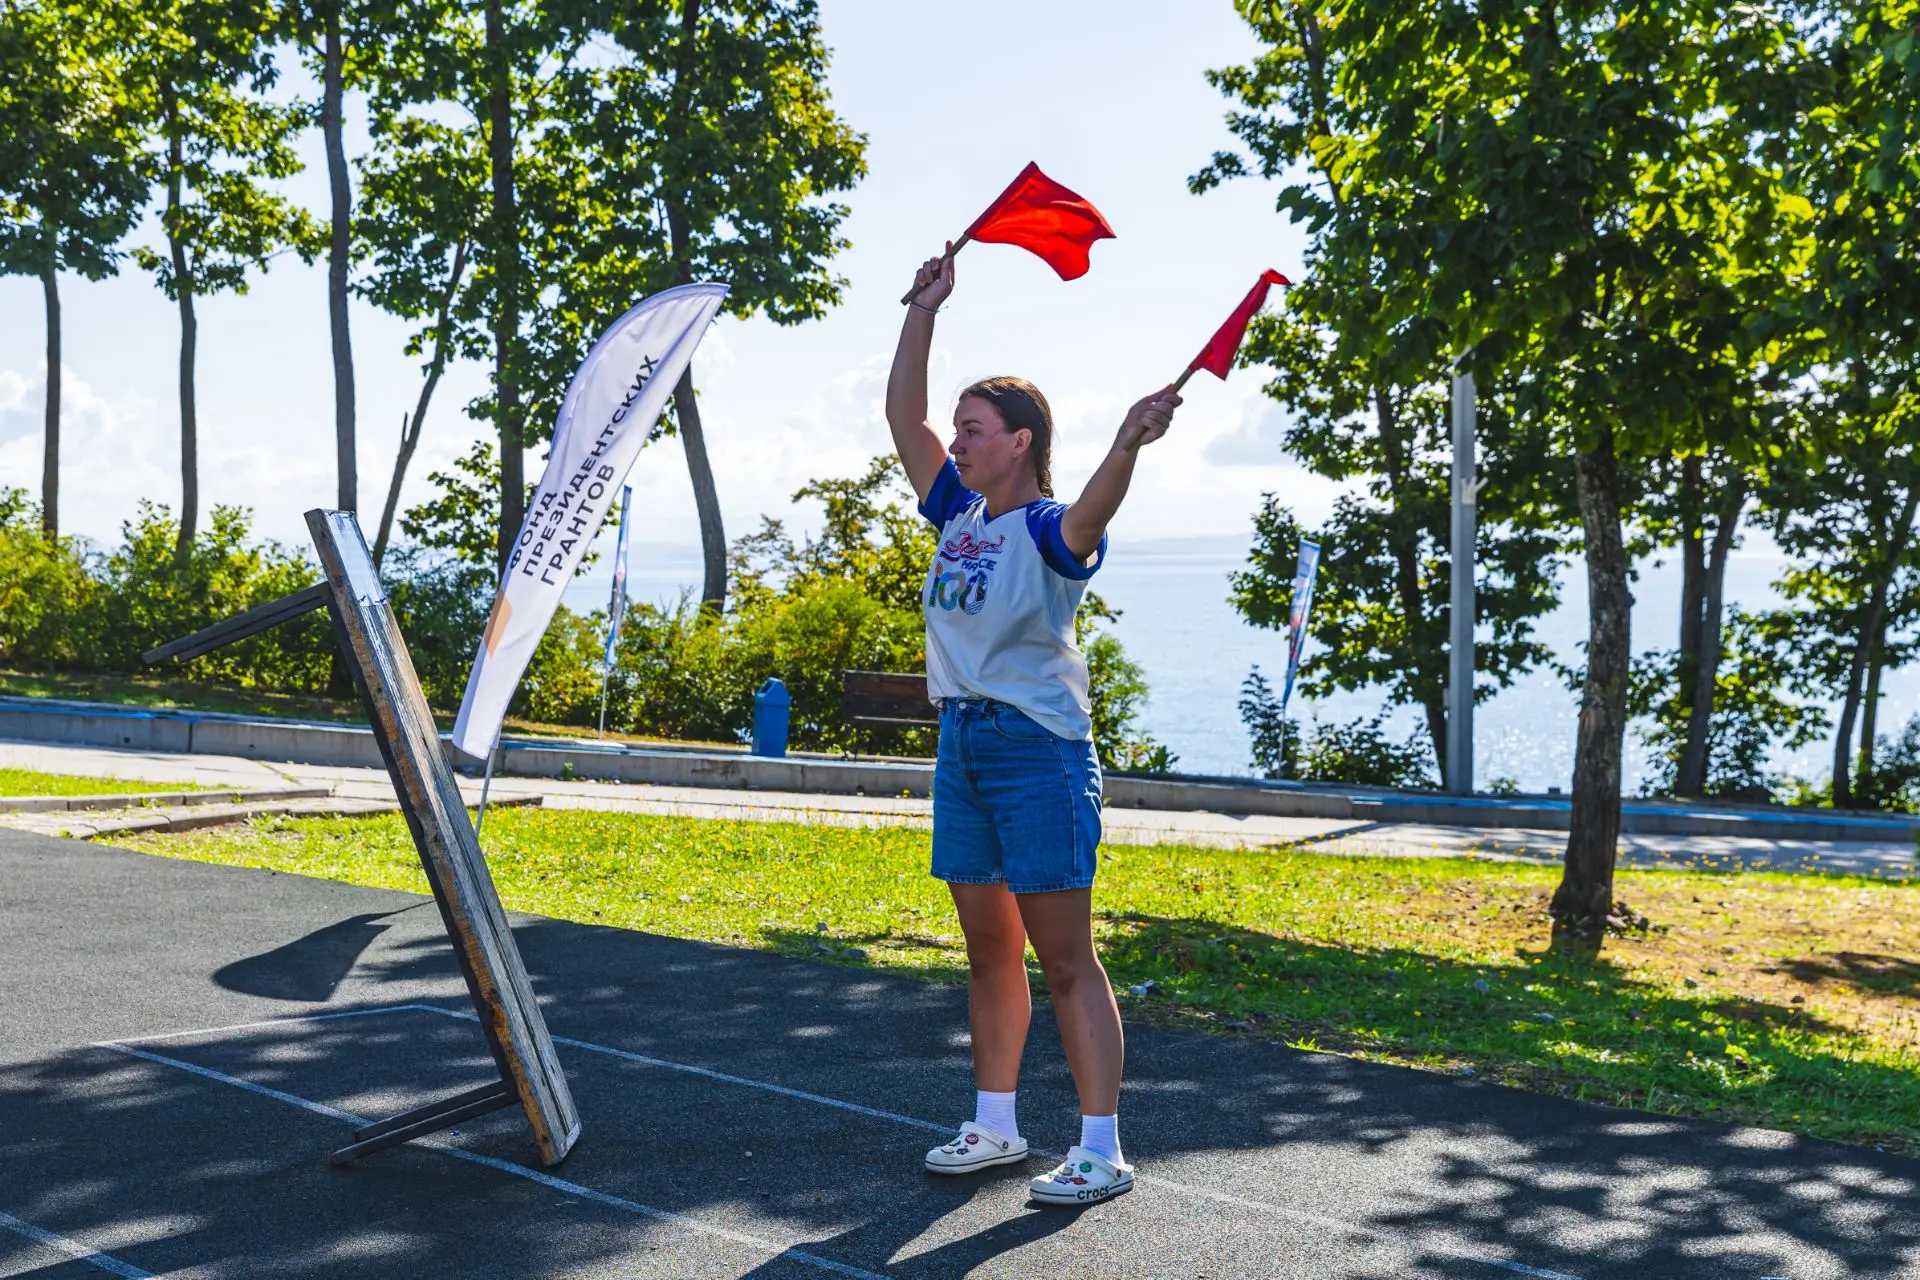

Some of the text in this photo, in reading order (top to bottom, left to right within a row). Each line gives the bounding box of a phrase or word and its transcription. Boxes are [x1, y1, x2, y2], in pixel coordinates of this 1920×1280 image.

[522, 354, 659, 577] ПРЕЗИДЕНТСКИХ
[510, 492, 558, 569] ФОНД
[540, 464, 615, 586] ГРАНТОВ
[1076, 1185, 1110, 1200] crocs
